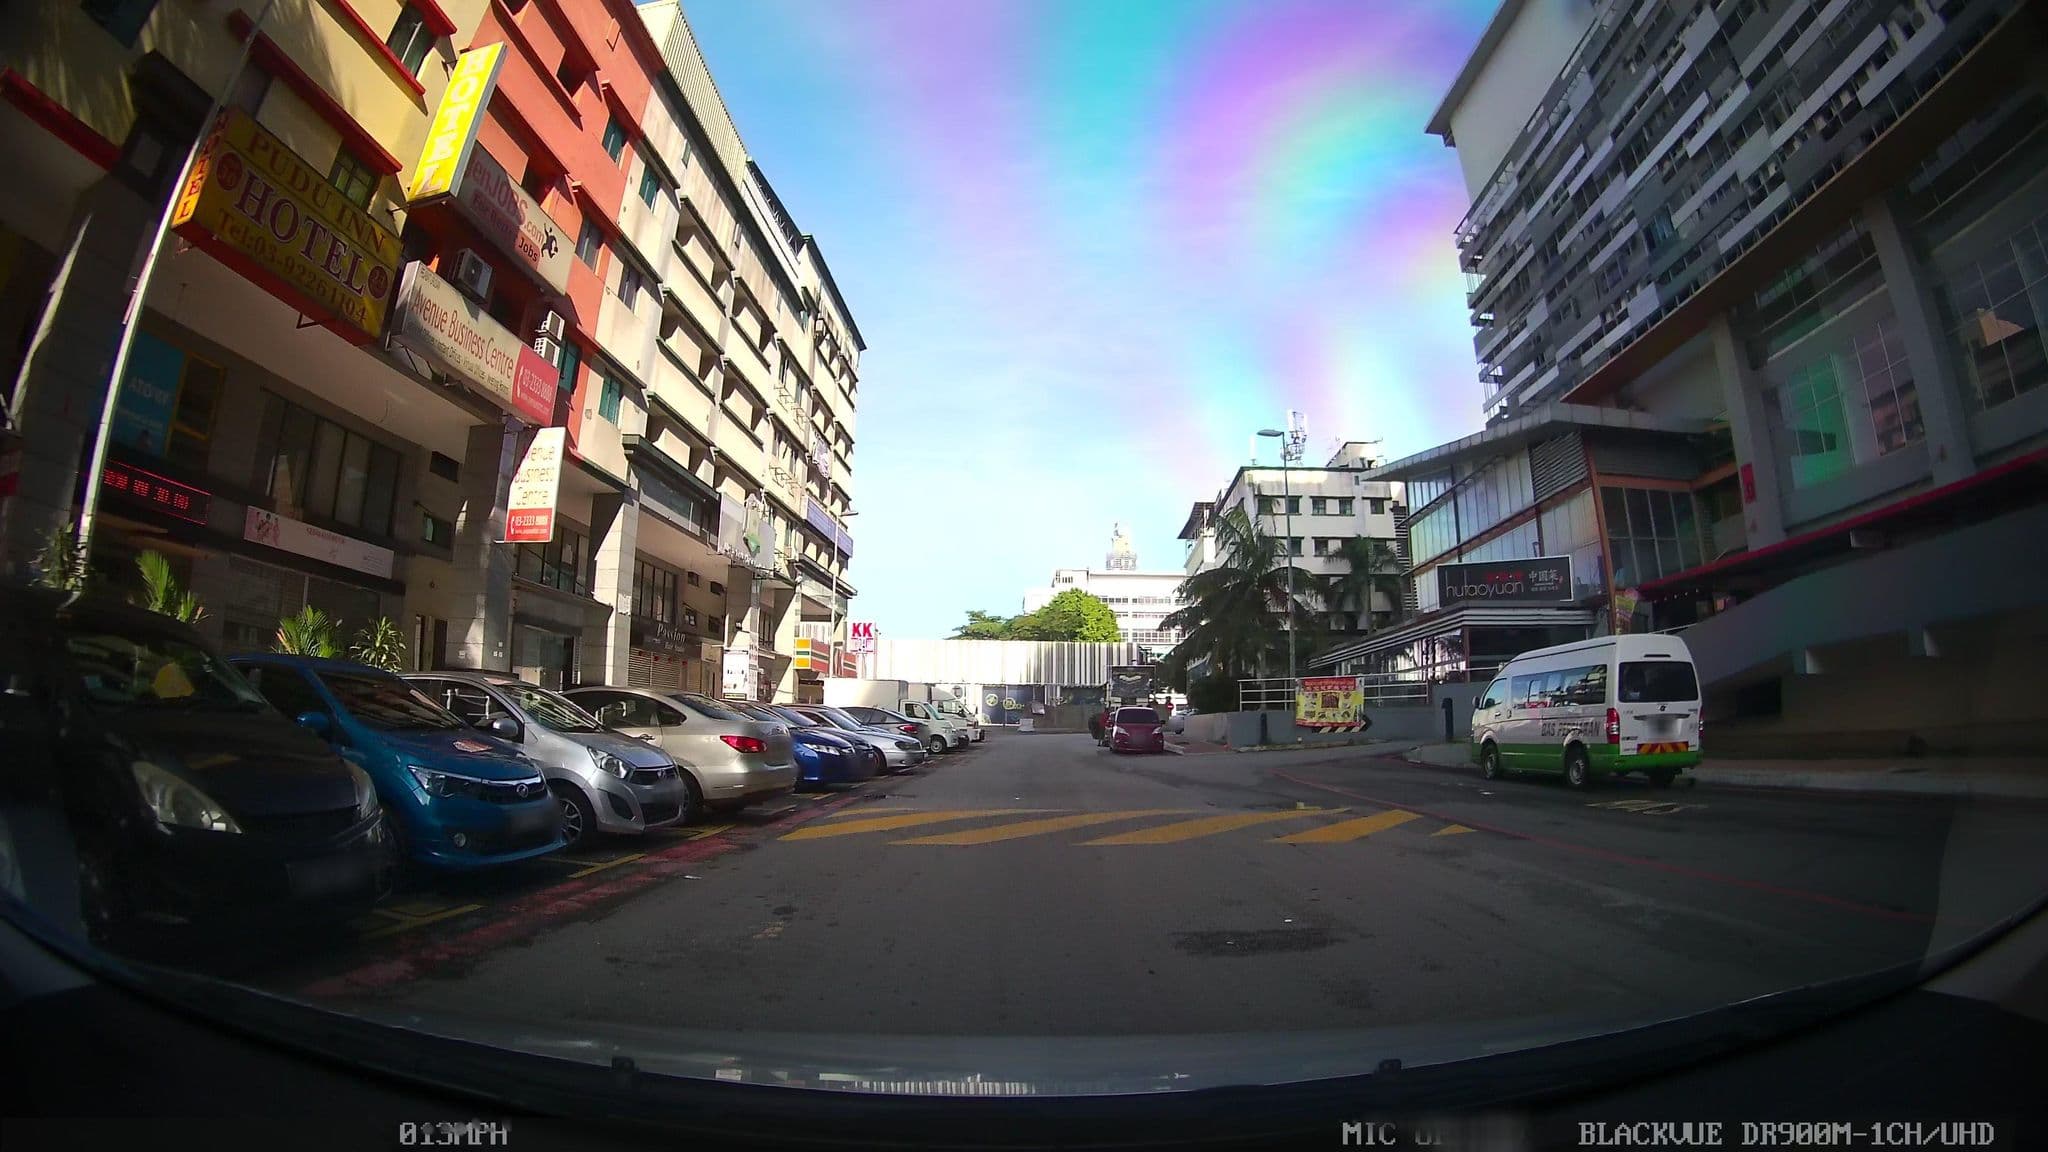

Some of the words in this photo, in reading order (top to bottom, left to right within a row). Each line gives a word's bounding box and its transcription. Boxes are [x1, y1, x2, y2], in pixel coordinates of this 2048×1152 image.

[415, 51, 488, 197] HOTEL
[234, 166, 366, 297] HOTEL
[248, 131, 332, 208] PUDU
[335, 207, 387, 254] INN
[517, 236, 539, 262] Jobs
[411, 287, 450, 334] Avenue
[447, 309, 486, 361] Business
[485, 337, 515, 380] Centre
[851, 622, 873, 638] KK
[1444, 567, 1524, 600] hutaoyuan
